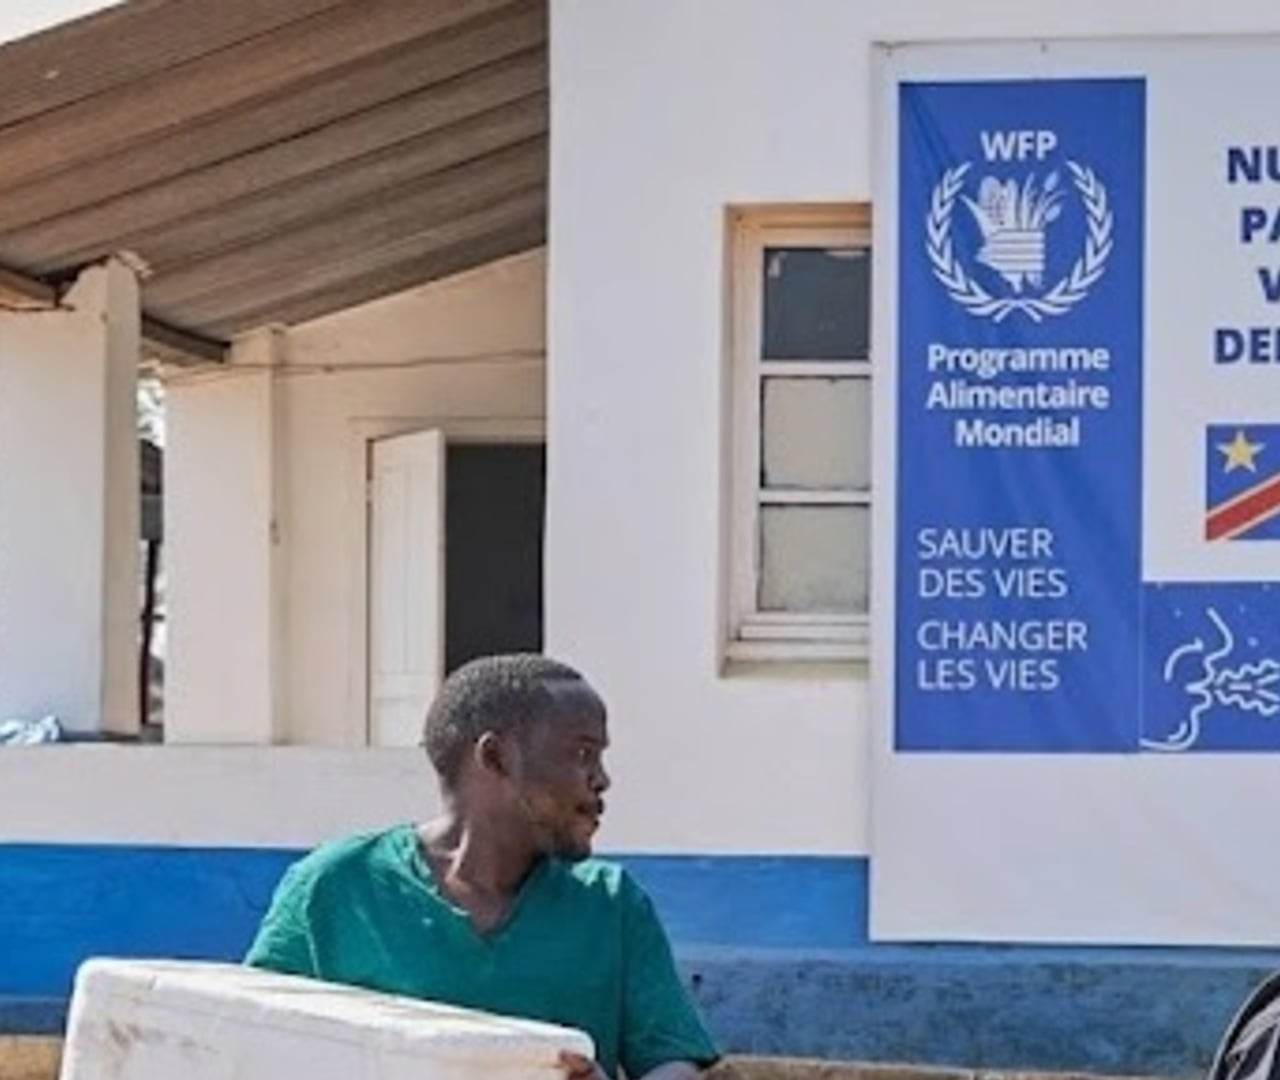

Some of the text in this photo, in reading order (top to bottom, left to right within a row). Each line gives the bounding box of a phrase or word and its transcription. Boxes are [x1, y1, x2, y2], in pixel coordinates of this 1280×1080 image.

[980, 131, 1057, 161] WFP
[927, 344, 1110, 378] Programme
[927, 379, 1110, 409] Alimentaire
[955, 417, 1080, 447] Mondial
[917, 527, 1054, 560] SAUVER
[920, 568, 1068, 599] DES VIES
[917, 619, 1088, 651] CHANGER
[918, 659, 1060, 691] LES VIES
